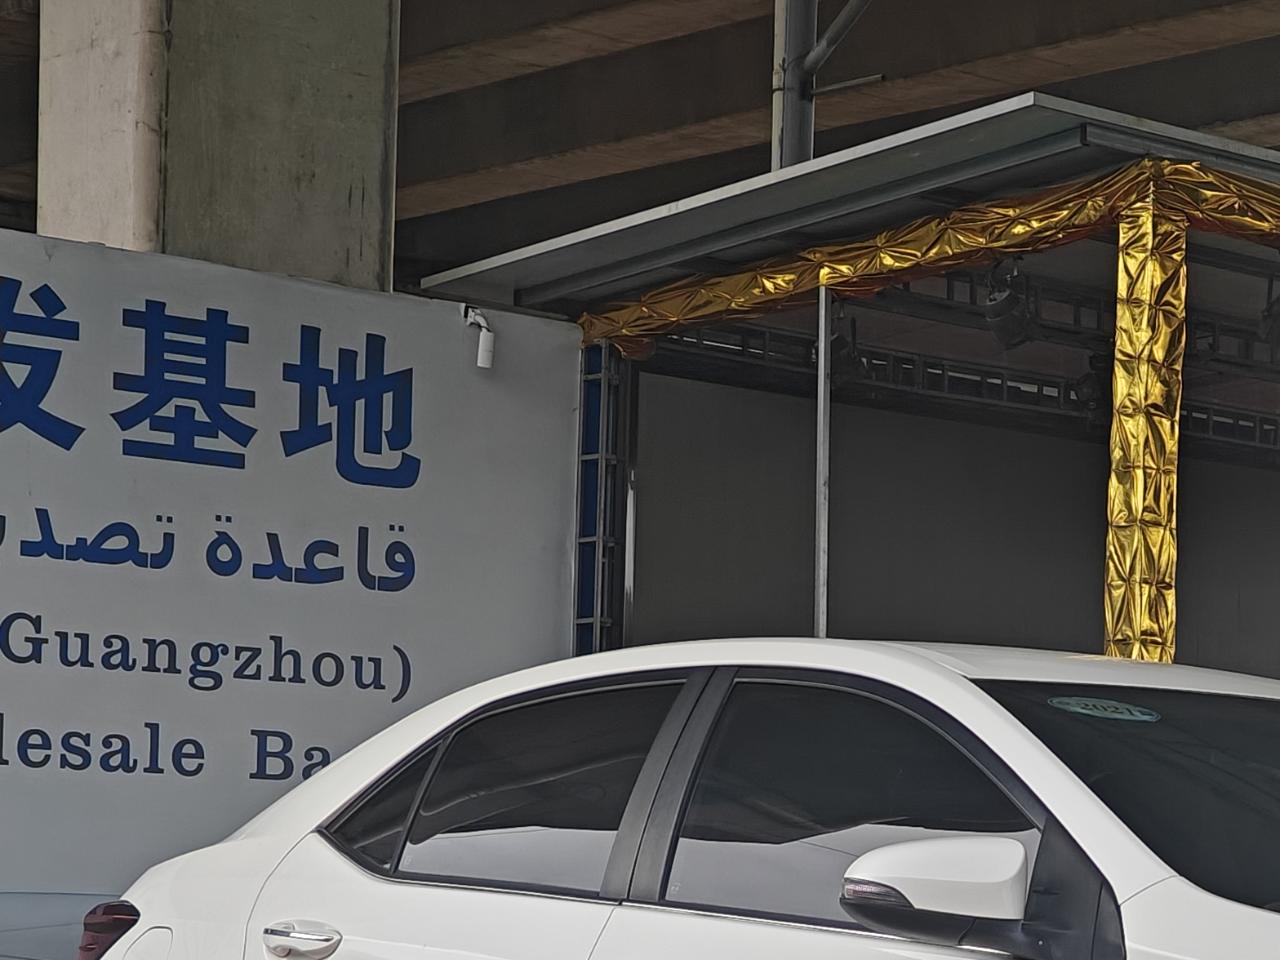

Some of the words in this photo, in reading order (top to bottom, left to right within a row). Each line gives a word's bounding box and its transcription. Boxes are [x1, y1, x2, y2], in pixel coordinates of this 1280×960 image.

[0, 507, 176, 570] تصد
[205, 514, 417, 593] قاعدة
[0, 612, 412, 702] Guangzhou)
